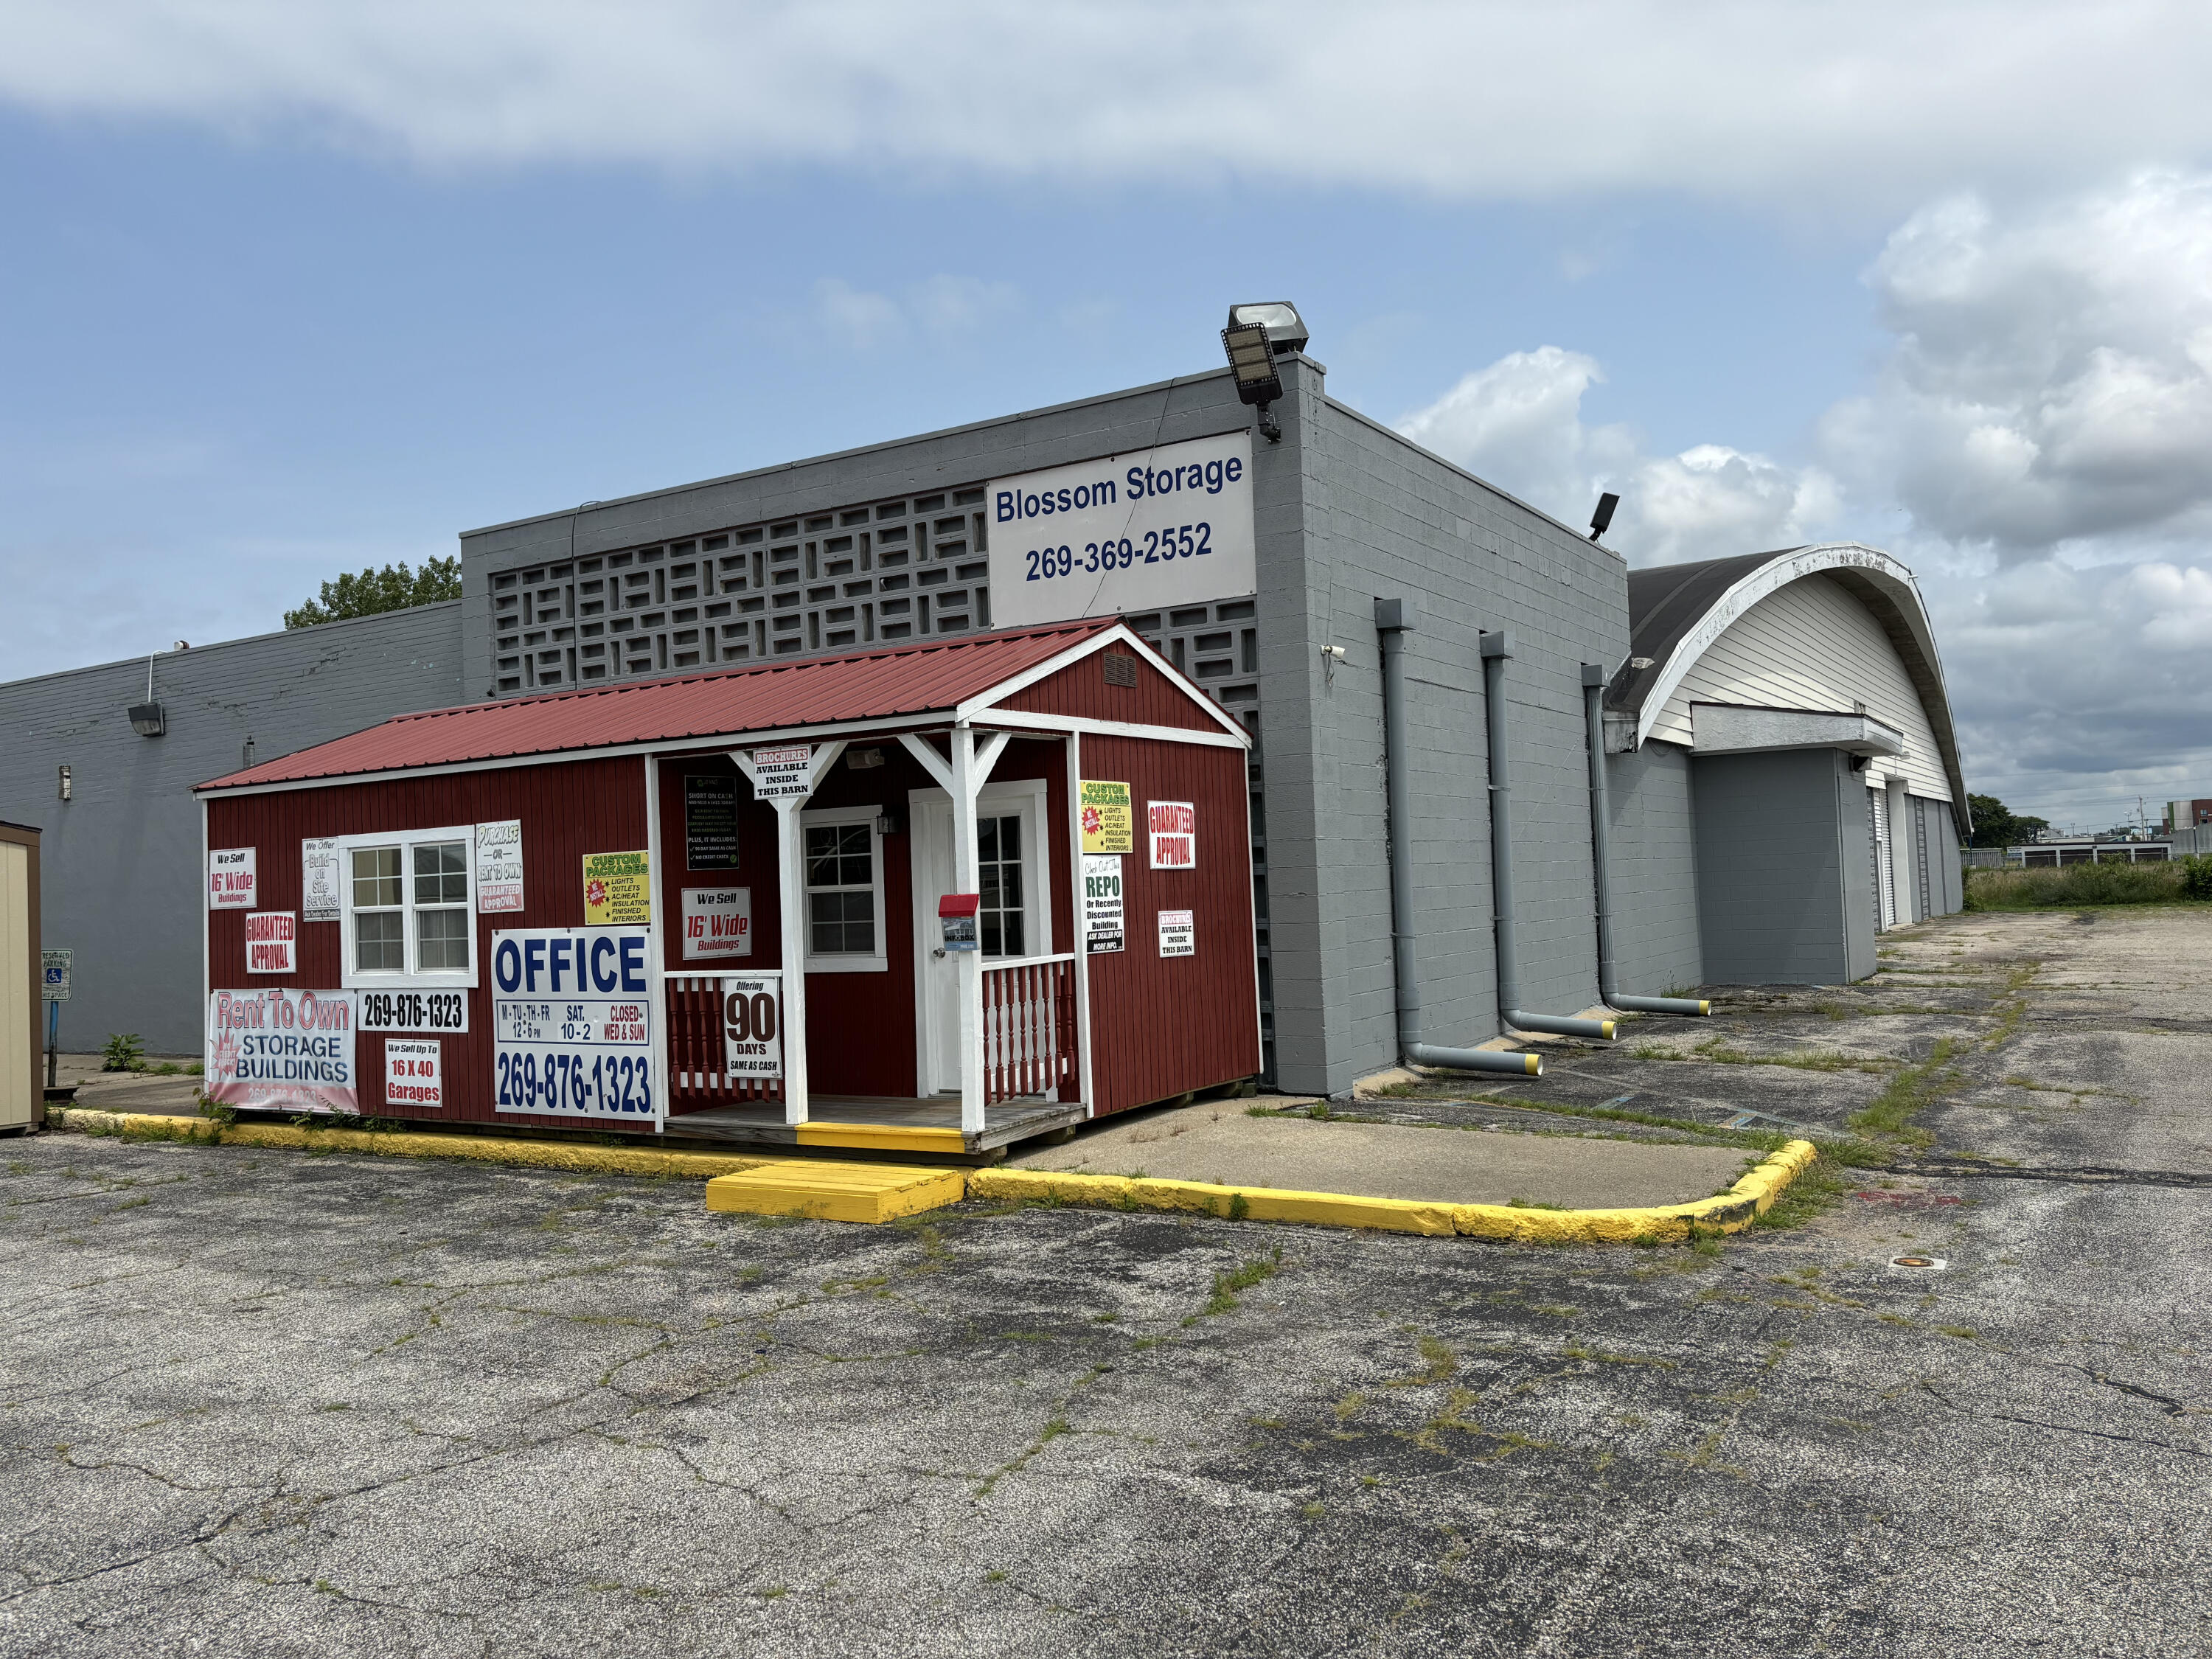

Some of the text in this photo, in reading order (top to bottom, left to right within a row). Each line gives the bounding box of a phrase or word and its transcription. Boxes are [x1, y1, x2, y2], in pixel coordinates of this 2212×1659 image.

[997, 457, 1242, 522] Blossom Storage
[1026, 522, 1211, 581] 269-369-2552
[757, 750, 807, 763] BROCHURES
[757, 762, 807, 773] AVAILABLE
[766, 775, 798, 784] INSIDE
[757, 785, 808, 796] THIS BARN
[1086, 783, 1124, 795] CUSTOM
[1082, 793, 1129, 804] PACKAGES
[1150, 805, 1194, 834] GUARANTEED
[478, 825, 518, 849] PURCHASE
[318, 841, 335, 849] Offer
[1156, 837, 1190, 865] APPROVAL
[218, 853, 245, 864] We Sell
[310, 853, 330, 868] Build
[493, 849, 502, 860] OR
[592, 854, 641, 866] CUSTOM
[316, 869, 325, 879] on
[478, 863, 521, 882] RENT TO OWN
[586, 863, 648, 877] PACKAGES
[212, 872, 253, 891] 16' Wide
[313, 880, 330, 894] Site
[591, 883, 598, 891] WE
[1085, 875, 1120, 897] REPO
[480, 885, 520, 897] GUARANTEED
[590, 889, 604, 902] INSTALL
[218, 893, 247, 903] Buildings
[306, 893, 337, 907] Service
[484, 895, 517, 909] APPROVAL
[698, 893, 737, 904] We Sell
[1096, 899, 1121, 908] Recently
[1087, 909, 1121, 919] Discounted
[246, 915, 293, 942] GUARANTEED
[687, 914, 748, 938] 16' Wide
[1092, 921, 1118, 930] Building
[1161, 925, 1192, 933] AVAILABLE
[1088, 931, 1122, 940] ASK DEALER FOR
[698, 939, 740, 950] Buildings
[1093, 943, 1106, 951] MORE
[251, 944, 289, 970] APPROVAL
[495, 936, 647, 992] OFFICE
[737, 981, 764, 991] Offering
[218, 990, 349, 1030] Rent To Own
[365, 994, 462, 1028] 269-876-1323
[566, 1005, 585, 1021] SAT.
[611, 1005, 639, 1022] CLOSED
[726, 992, 775, 1042] 90
[534, 1029, 540, 1038] PM
[604, 1023, 645, 1041] WED & SUN
[243, 1034, 341, 1058] STORAGE
[389, 1044, 437, 1054] We Sell Up To
[737, 1043, 767, 1055] DAYS
[236, 1058, 348, 1082] BUILDINGS
[392, 1060, 433, 1077] 16 X 40
[731, 1061, 777, 1071] SAME AS CASH
[498, 1052, 651, 1113] 269-876-1323
[388, 1082, 439, 1102] Garages
